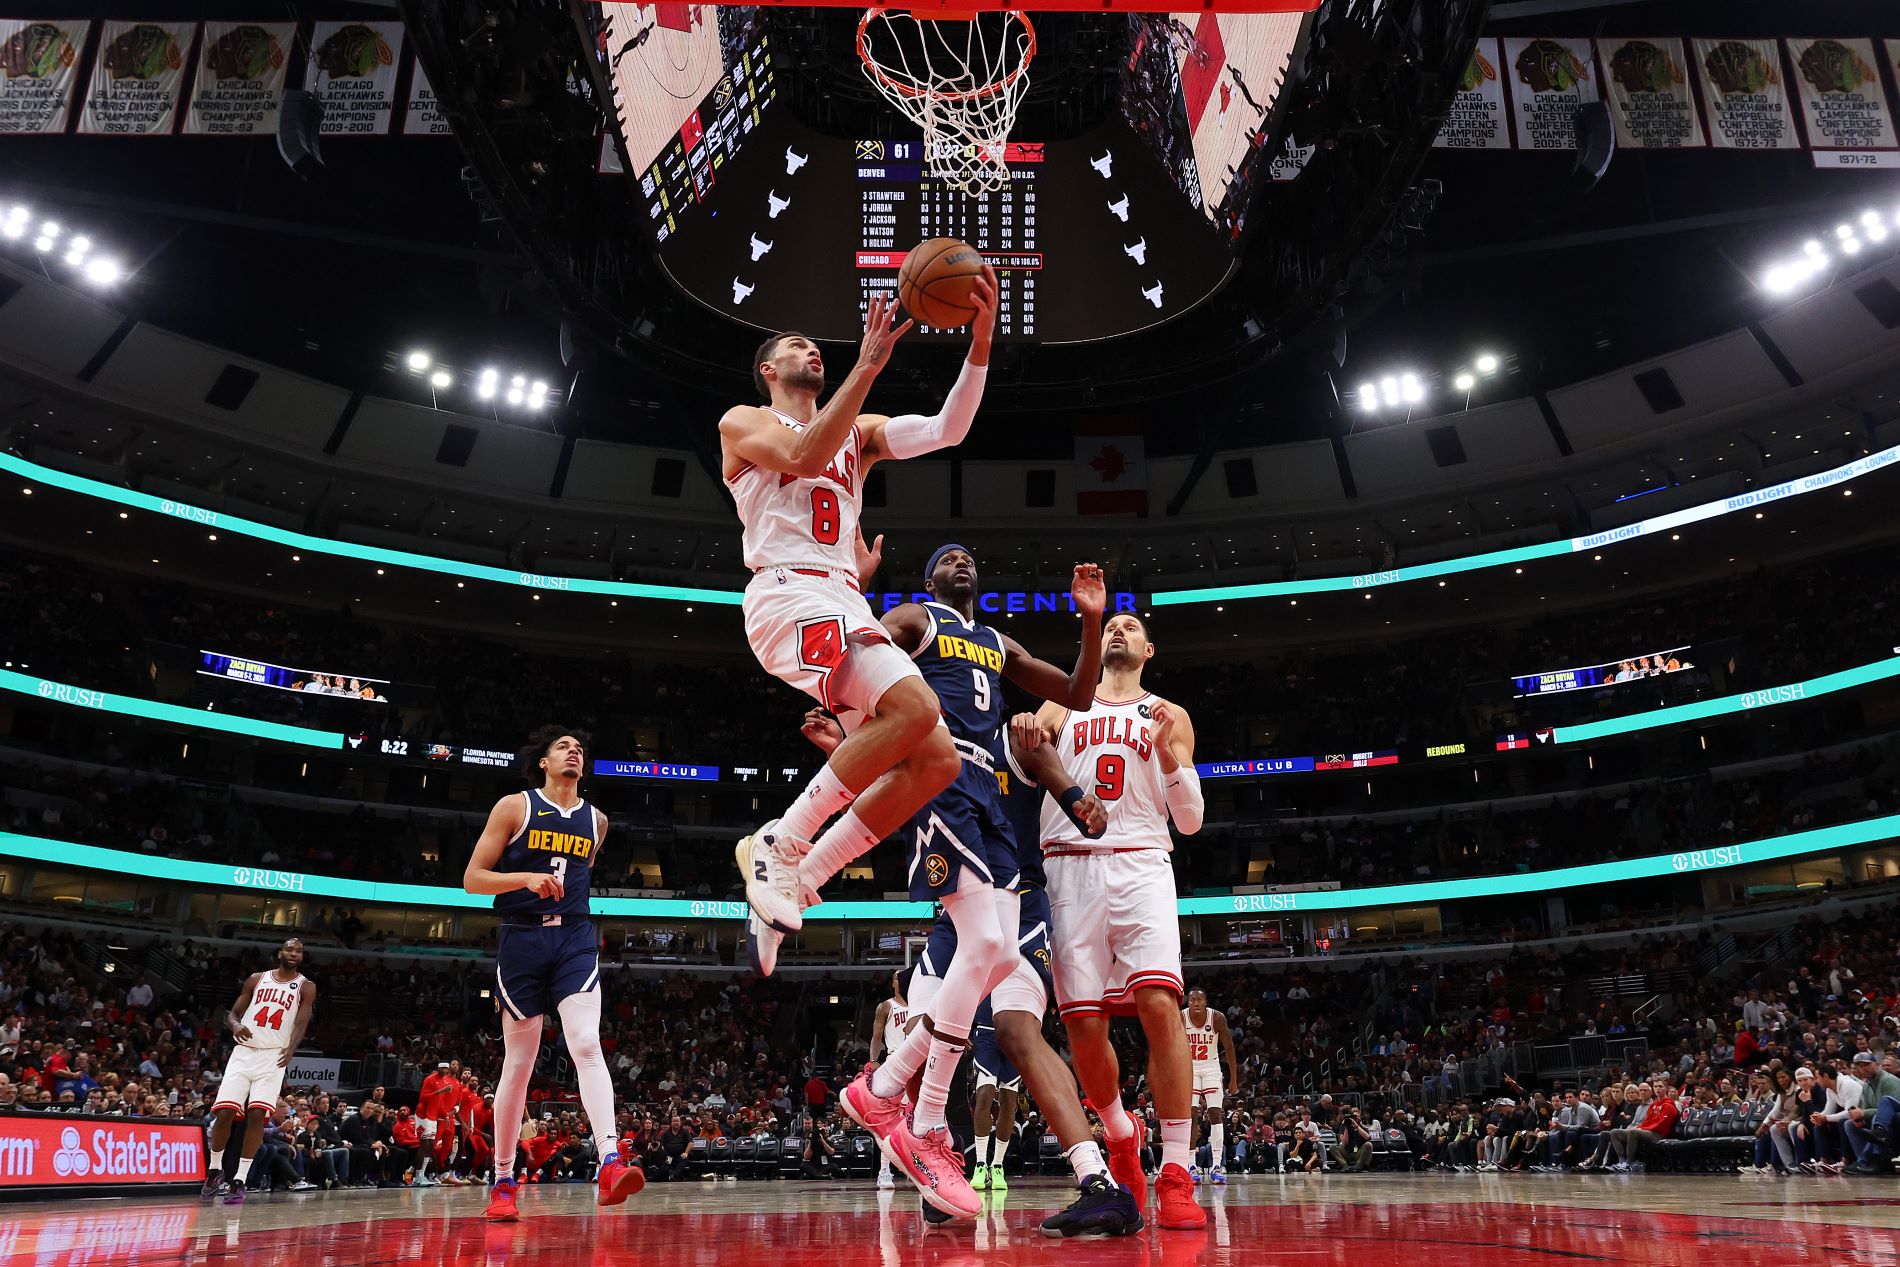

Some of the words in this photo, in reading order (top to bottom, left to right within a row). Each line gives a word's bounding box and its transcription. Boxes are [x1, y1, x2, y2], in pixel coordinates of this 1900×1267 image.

[113, 80, 159, 90] CHICAGO
[217, 81, 263, 90] CHICAGO
[327, 81, 374, 90] CHICAGO
[96, 91, 169, 100] BLACKHAWKS
[201, 91, 273, 100] BLACKHAWKS
[1534, 94, 1577, 103] CHICAGO
[1630, 93, 1674, 102] CHICAGO
[1724, 94, 1767, 103] CHICAGO
[1821, 93, 1864, 102] CHICAGO
[21, 100, 66, 110] DIVISON
[88, 101, 126, 110] NORRIS
[192, 101, 231, 110] NORRIS
[352, 101, 391, 110] DIVISION
[1523, 103, 1582, 112] BLACKHAW
[1620, 102, 1689, 111] BLACKHAWKS
[1714, 102, 1782, 111] BLACKHAWKS
[1812, 101, 1879, 110] BLACKHAWKS
[96, 112, 159, 121] CHAMPIONS
[321, 112, 375, 121] HAMPIONS
[1450, 111, 1489, 120] ESTERN
[1532, 112, 1574, 121] WESTE
[1629, 111, 1685, 120] CAMPBELL
[1722, 112, 1778, 121] CAMPBELL
[1819, 110, 1875, 119] CAMPBELL
[321, 123, 374, 132] 009-2010
[1526, 121, 1575, 130] CONFERE
[1625, 120, 1692, 129] CONFERENCE
[1718, 120, 1785, 130] CONFERENCE
[1816, 119, 1883, 129] CONFERENCE
[1437, 129, 1495, 138] CHAMPIONS
[1532, 130, 1576, 139] CHAMPIO
[1631, 129, 1689, 138] CHAMPIONS
[1725, 129, 1783, 139] CHAMPIONS
[1822, 128, 1880, 138] CHAMPIONS
[1447, 138, 1486, 147] 2012-13
[1734, 138, 1777, 148] 1972-73
[893, 143, 909, 159] 61
[1839, 154, 1877, 164] 1971-72
[858, 168, 886, 178] DENVER
[862, 192, 868, 201] 3
[869, 192, 905, 202] STRAWTHER
[921, 192, 929, 201] 11
[1002, 193, 1012, 202] 2/5
[869, 204, 893, 213] JORDAN
[863, 215, 868, 225] 7
[869, 215, 896, 225] JACKSON
[869, 227, 894, 236] WATSON
[921, 228, 929, 237] 12
[869, 239, 893, 248] HOLIDAY
[1001, 240, 1012, 249] 2/4
[858, 256, 889, 265] CHICAGO
[861, 278, 868, 287] 12
[863, 290, 868, 299] 9
[869, 290, 893, 299] VUCIC
[859, 301, 868, 310] 44
[920, 325, 929, 334] 20
[1001, 326, 1011, 335] 1/4
[1804, 466, 1854, 489] CHAMPIONS
[1864, 450, 1897, 470] LOUNGE
[1727, 494, 1754, 510] BUD
[1755, 484, 1793, 503] LIGHT
[175, 504, 218, 525] RUSH
[810, 486, 841, 547] 8
[1582, 532, 1608, 548] BUD
[1608, 524, 1642, 541] LIGHT
[1364, 570, 1400, 586] RUSH
[532, 576, 569, 590] RUSH
[979, 592, 1137, 613] CENTR
[937, 634, 1002, 673] DENVER
[1540, 674, 1555, 684] ZACH
[972, 667, 991, 712] 9
[1757, 682, 1806, 705] RUSH
[54, 683, 106, 709] RUSH
[1073, 716, 1152, 762] BULLS
[381, 739, 408, 756] 8:22
[1426, 743, 1466, 758] REBOUNDS
[463, 748, 486, 758] FLORIDA
[486, 750, 515, 760] PANTHERS
[1352, 752, 1373, 760] NUGGETS
[462, 756, 494, 766] MINNESOTA
[494, 759, 509, 767] WILD
[615, 764, 649, 774] ULTRA
[661, 766, 698, 777] CLUB
[733, 767, 758, 775] TIMEOUTS
[1212, 764, 1245, 774] ULTRA
[1256, 761, 1293, 771] CLUB
[1095, 753, 1126, 801] 9
[528, 829, 592, 859] DENVER
[1690, 845, 1743, 868] RUSH
[550, 856, 568, 887] 3
[251, 869, 305, 890] RUSH
[1251, 894, 1297, 910] RUSH
[255, 988, 295, 1011] BULLS
[253, 1005, 284, 1031] 44
